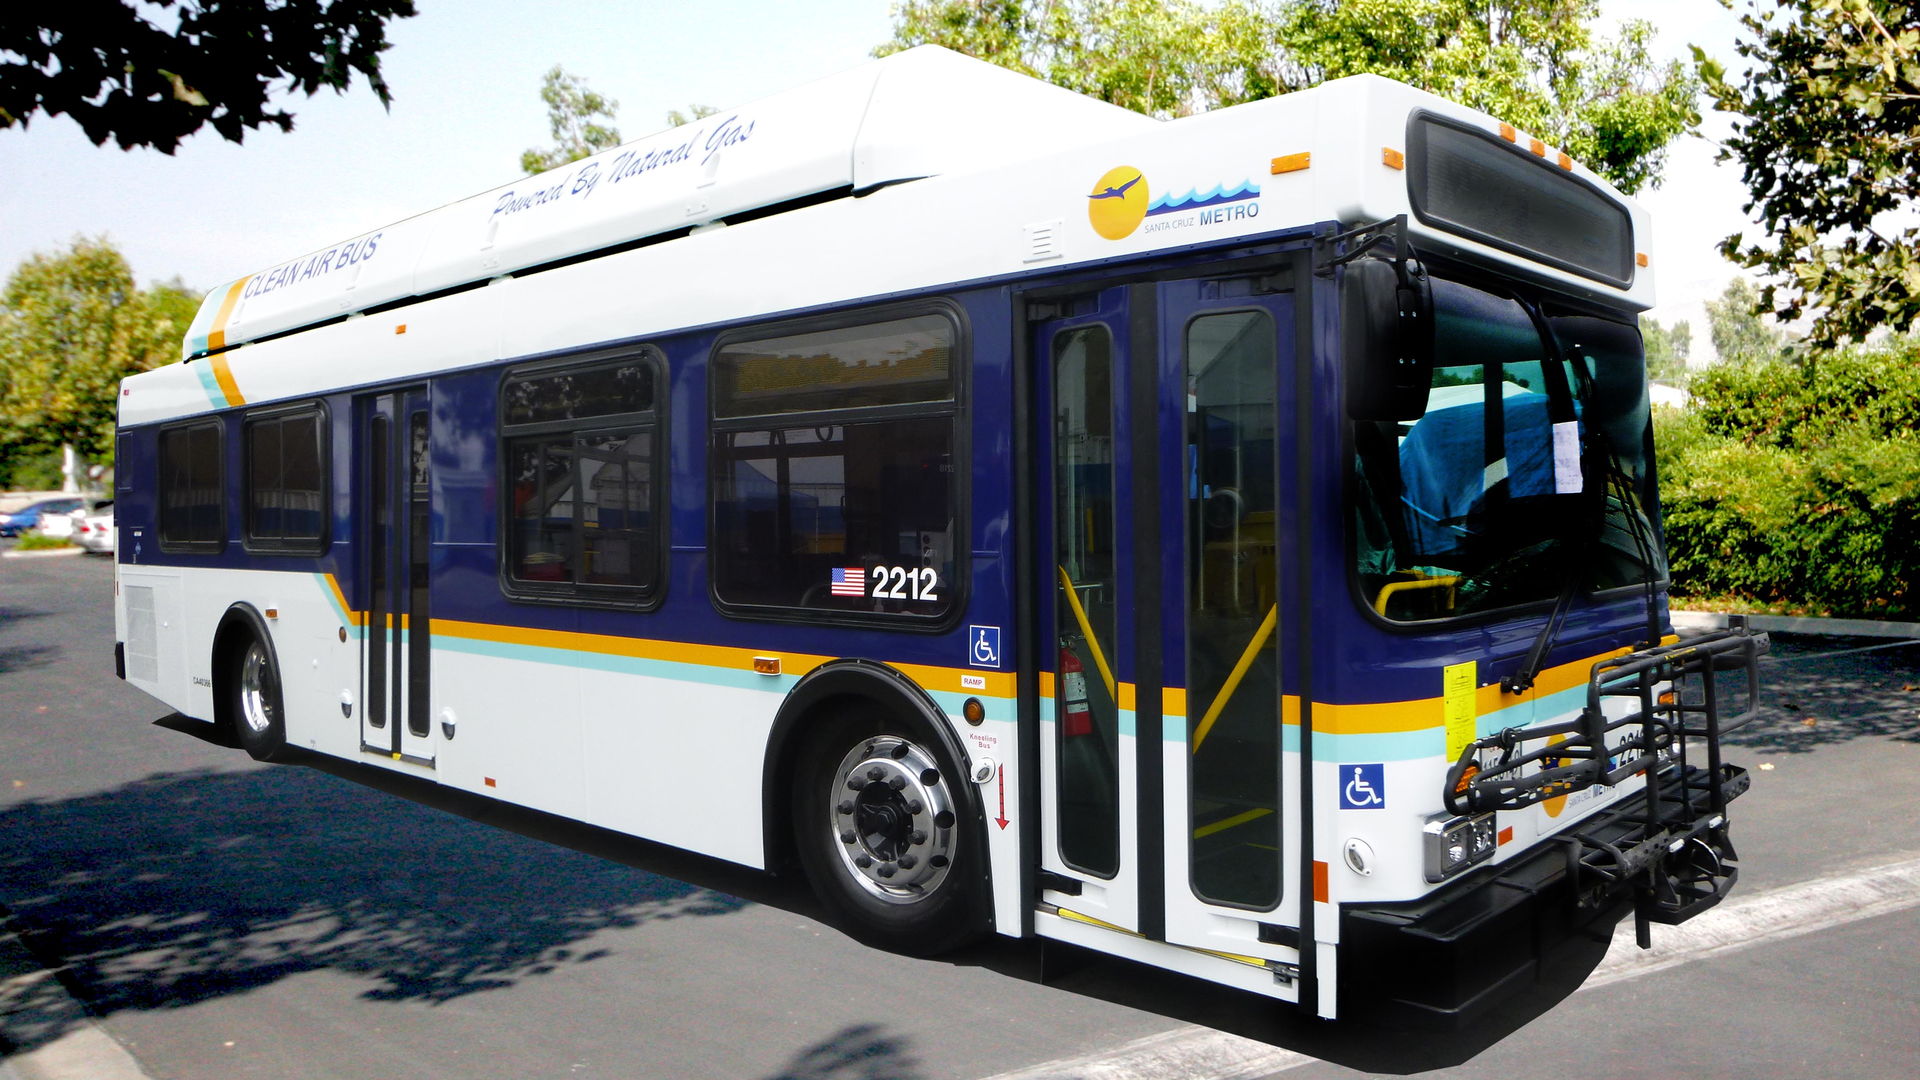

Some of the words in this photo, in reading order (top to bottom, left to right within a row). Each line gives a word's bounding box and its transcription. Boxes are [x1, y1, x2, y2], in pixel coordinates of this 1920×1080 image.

[488, 173, 573, 224] Powered
[571, 162, 602, 200] By
[607, 129, 704, 184] Natural
[701, 114, 756, 166] Gas
[1144, 221, 1170, 234] SANTA
[1172, 217, 1194, 229] CRUZ
[1200, 202, 1259, 226] METRO
[244, 262, 303, 299] CLEAN
[299, 249, 337, 282] AIR
[335, 233, 382, 270] BUS
[872, 565, 938, 601] 2212
[963, 678, 983, 686] RAMP
[970, 733, 997, 744] Kneeling
[978, 741, 991, 749] Bus
[1619, 729, 1644, 767] 221
